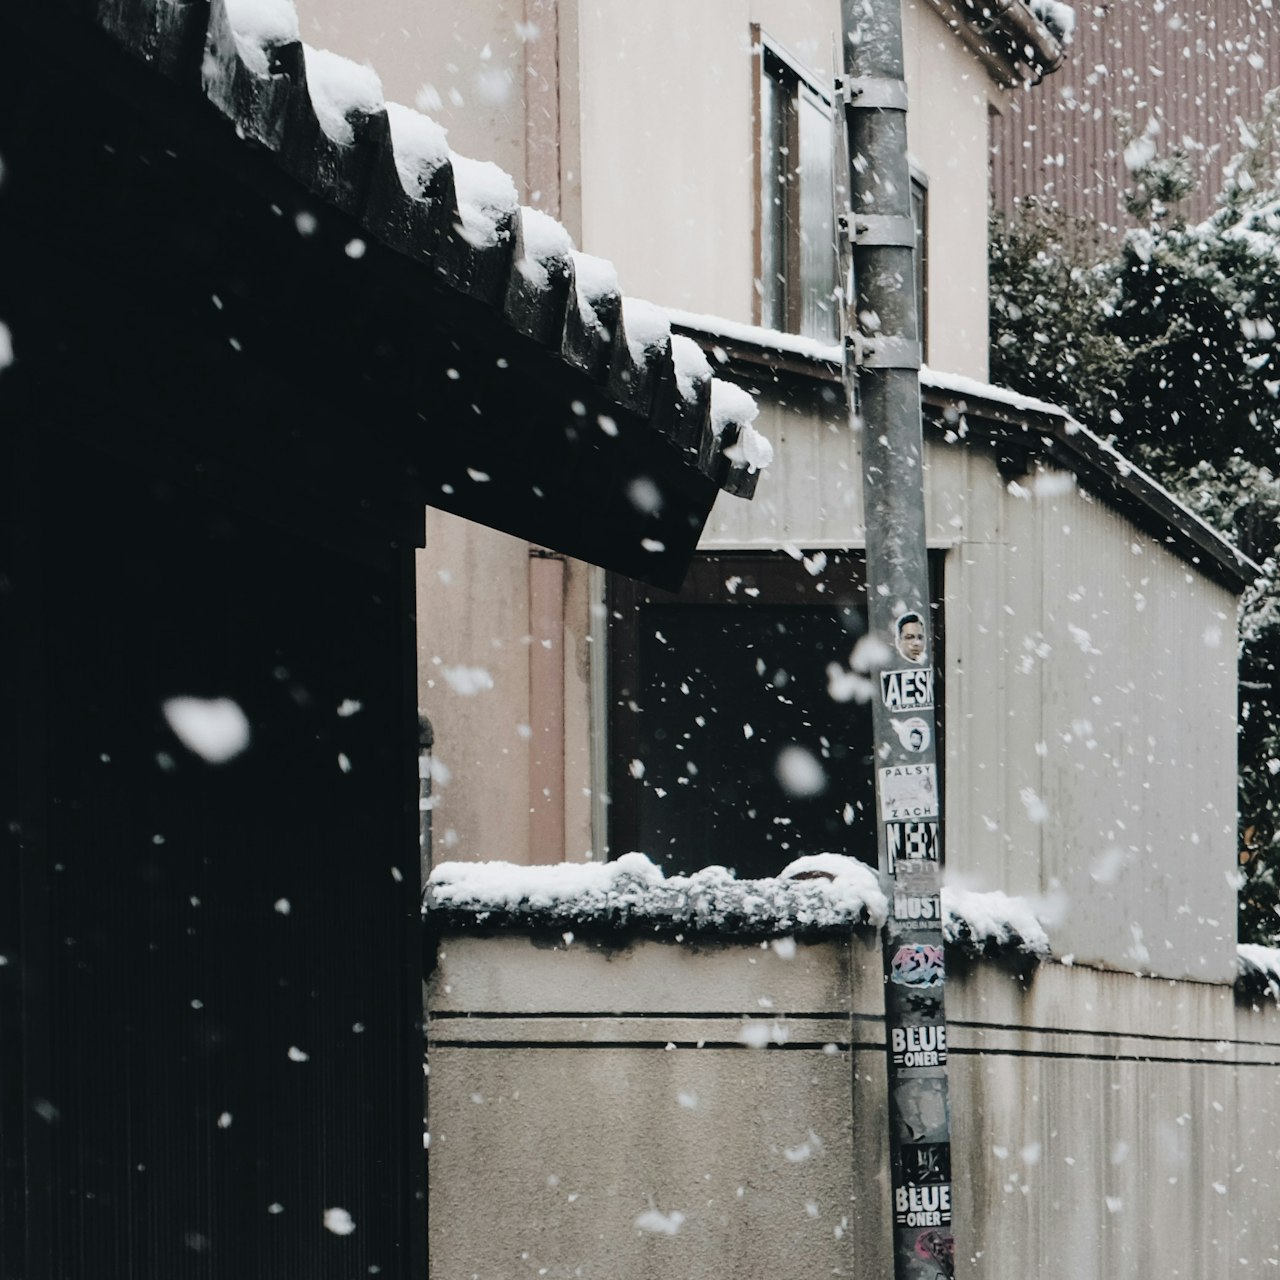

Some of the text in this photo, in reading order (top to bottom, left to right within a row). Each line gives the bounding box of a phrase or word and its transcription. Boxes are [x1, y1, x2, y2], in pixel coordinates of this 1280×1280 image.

[885, 766, 930, 777] PALSY
[891, 807, 931, 818] ZACH
[892, 1026, 945, 1052] BLUE
[896, 1186, 950, 1212] BLUE
